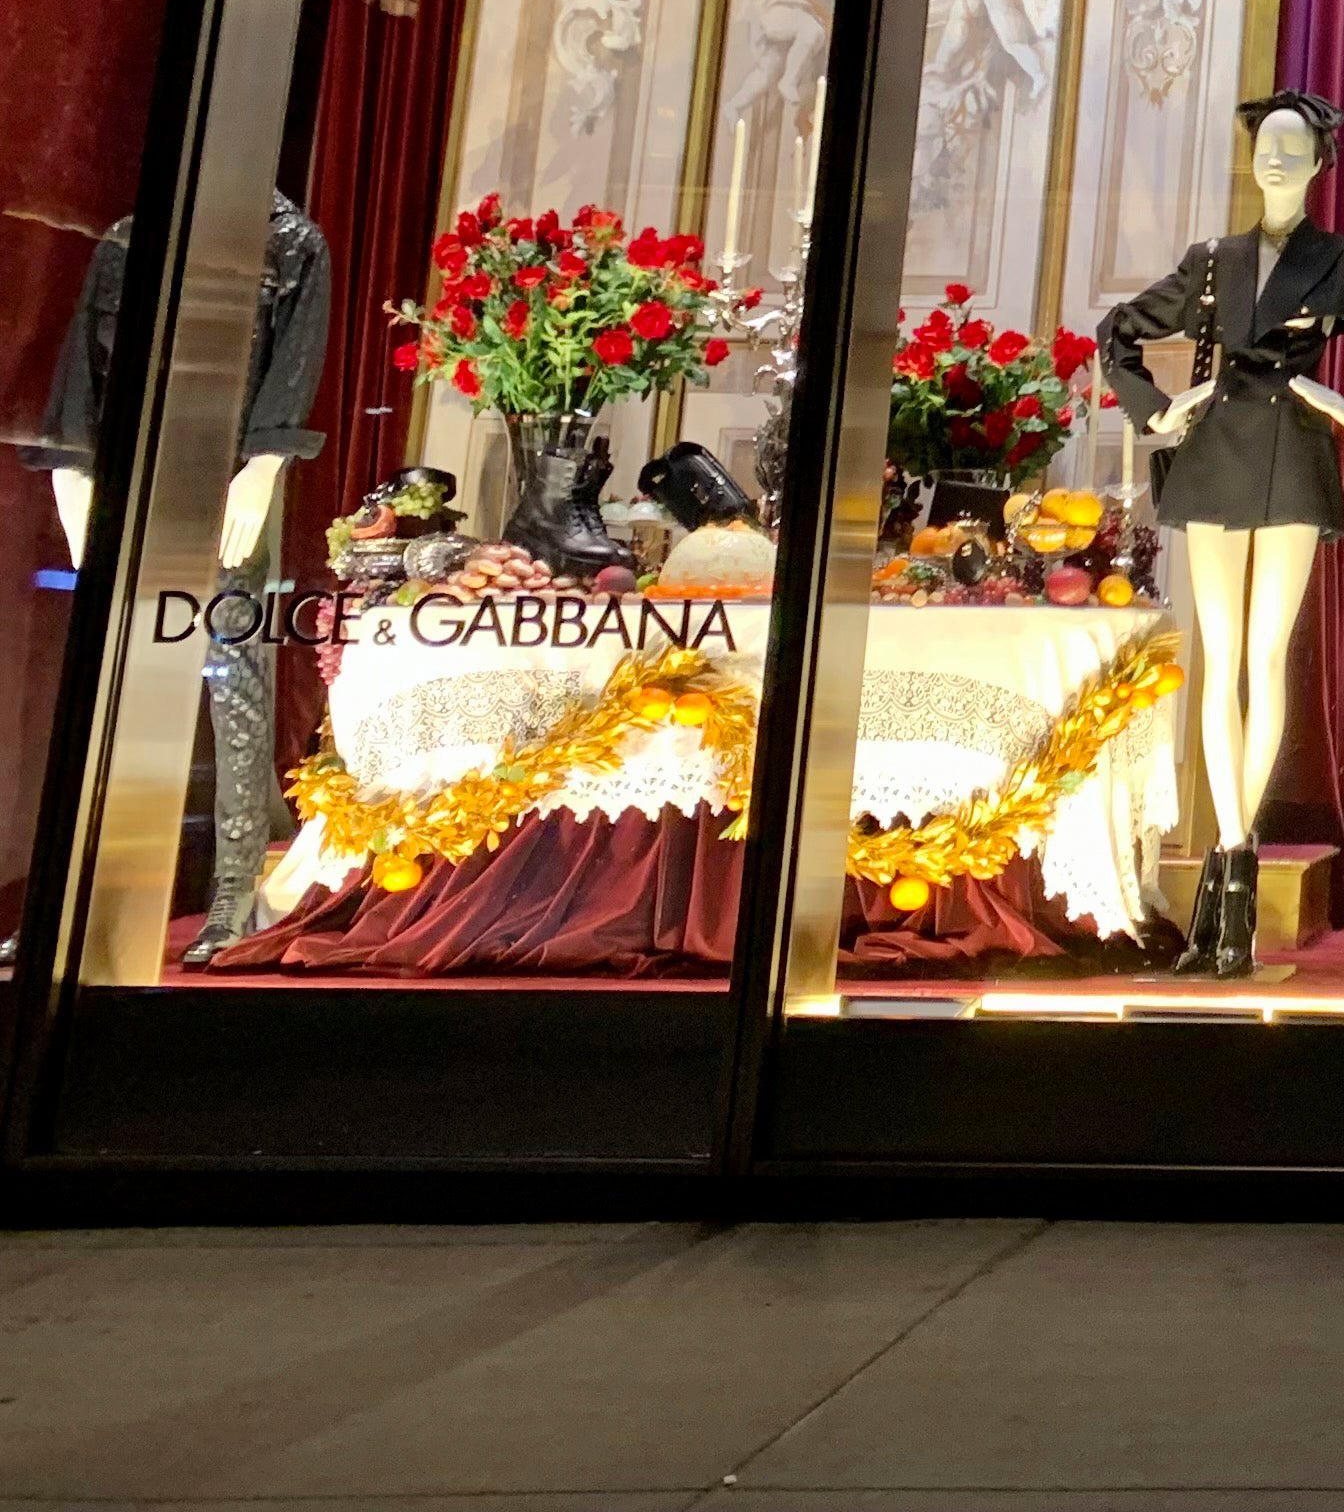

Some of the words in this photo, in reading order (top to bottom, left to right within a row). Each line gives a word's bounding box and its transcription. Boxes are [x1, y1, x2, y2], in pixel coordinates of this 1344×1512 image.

[152, 591, 364, 646] DOLCE
[372, 618, 397, 646] &
[409, 592, 738, 652] GABBANA
